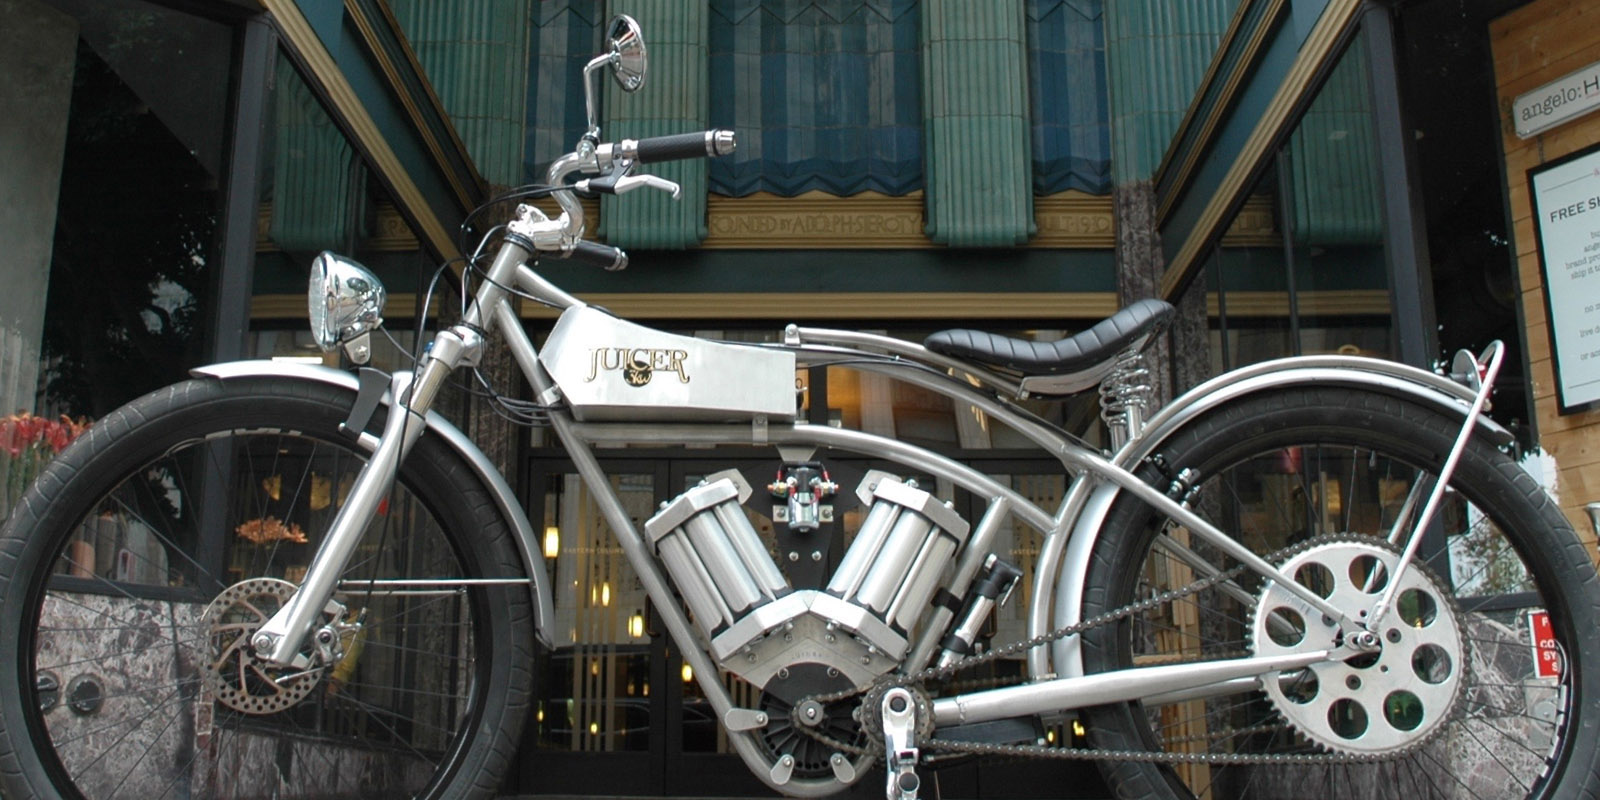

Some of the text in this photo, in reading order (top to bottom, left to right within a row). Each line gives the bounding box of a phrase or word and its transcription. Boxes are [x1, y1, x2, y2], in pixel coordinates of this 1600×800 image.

[1550, 200, 1587, 223] FREE
[710, 215, 777, 234] FOUNDED
[780, 218, 792, 231] BY
[583, 347, 690, 384] JUICER
